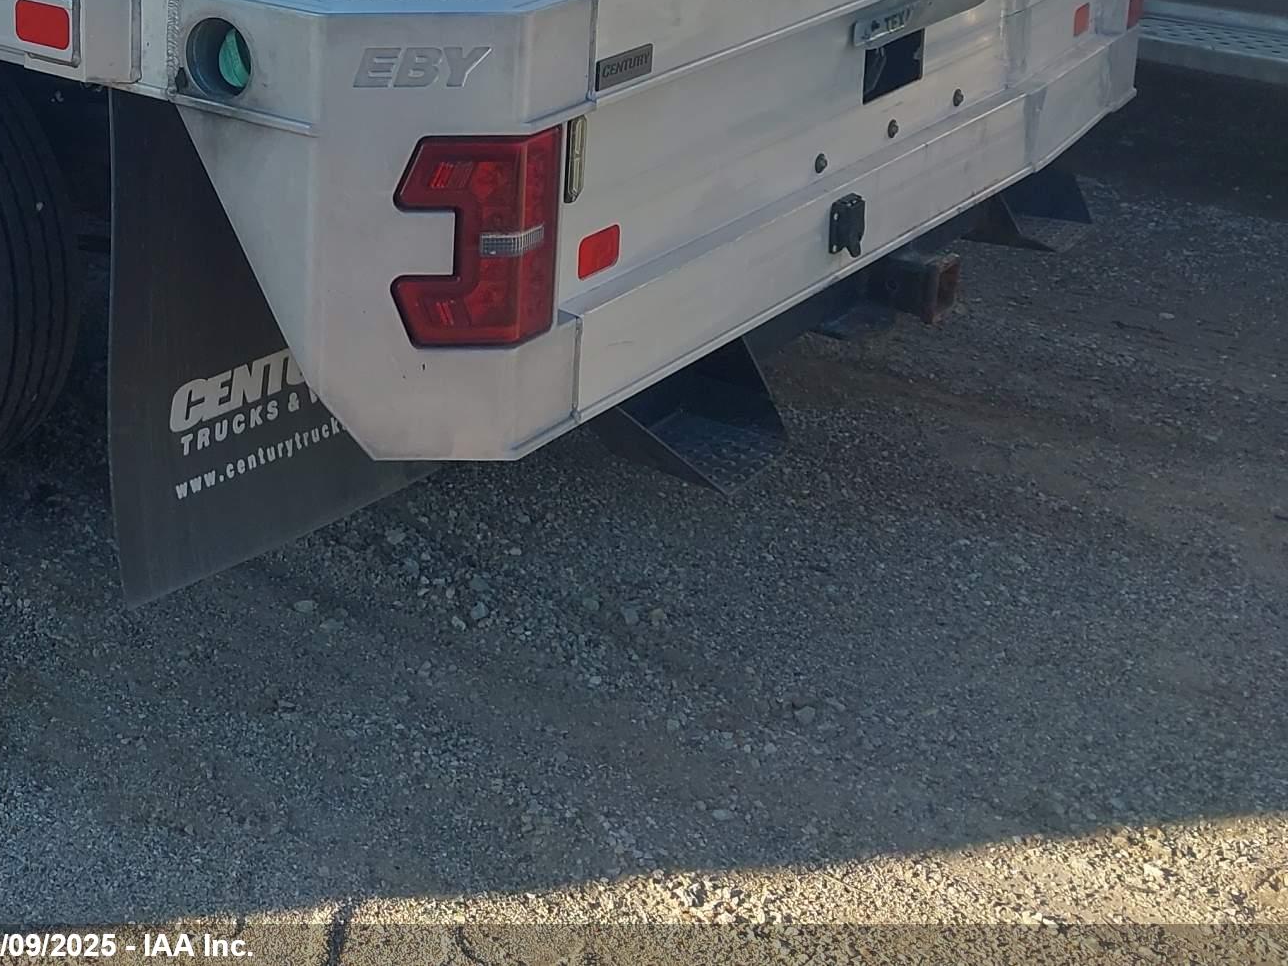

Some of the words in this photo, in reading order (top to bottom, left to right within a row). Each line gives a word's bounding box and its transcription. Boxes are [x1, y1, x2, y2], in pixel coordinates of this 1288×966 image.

[353, 46, 493, 88] EBY
[602, 49, 650, 78] CENTURY
[180, 400, 280, 456] TRUCKS
[288, 392, 300, 412] &
